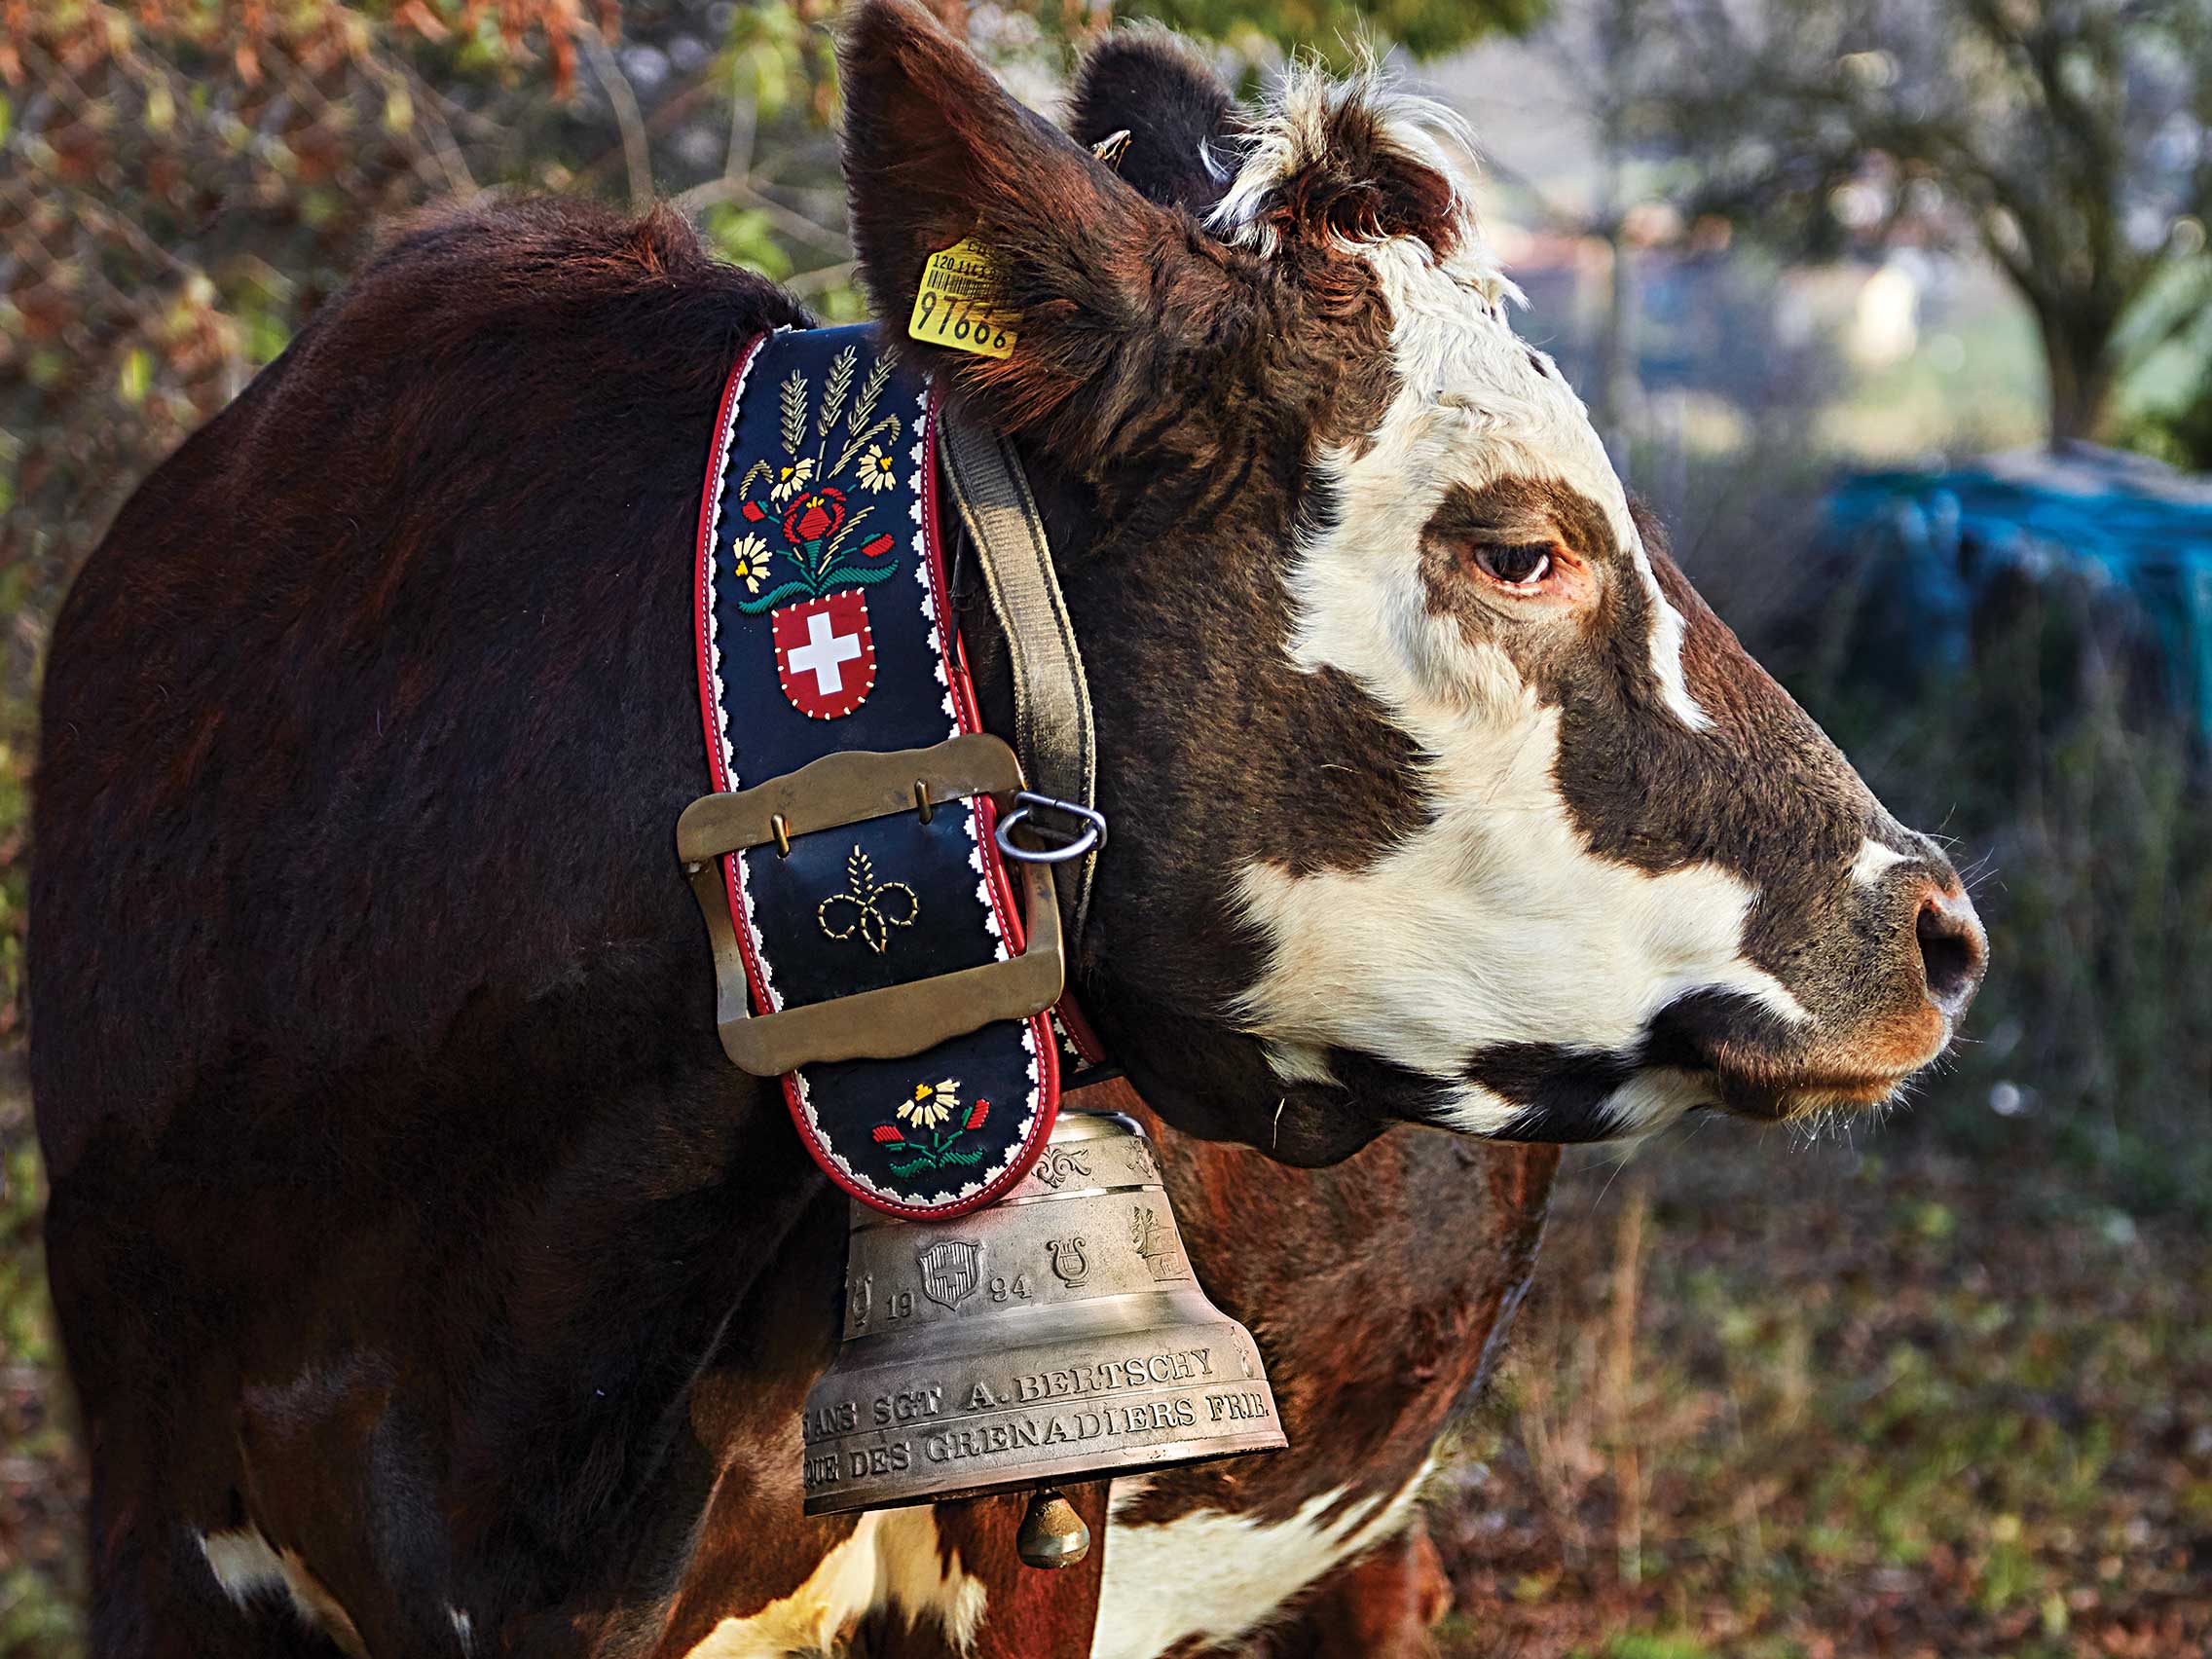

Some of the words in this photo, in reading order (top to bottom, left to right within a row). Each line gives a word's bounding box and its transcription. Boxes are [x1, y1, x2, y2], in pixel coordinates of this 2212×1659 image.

[886, 1290, 913, 1322] 19
[989, 1273, 1032, 1303] 94
[873, 1385, 943, 1426] SGT
[849, 1441, 911, 1478] DES
[926, 1399, 1197, 1464] GRENADIERS
[1205, 1392, 1271, 1421] FRIB.
